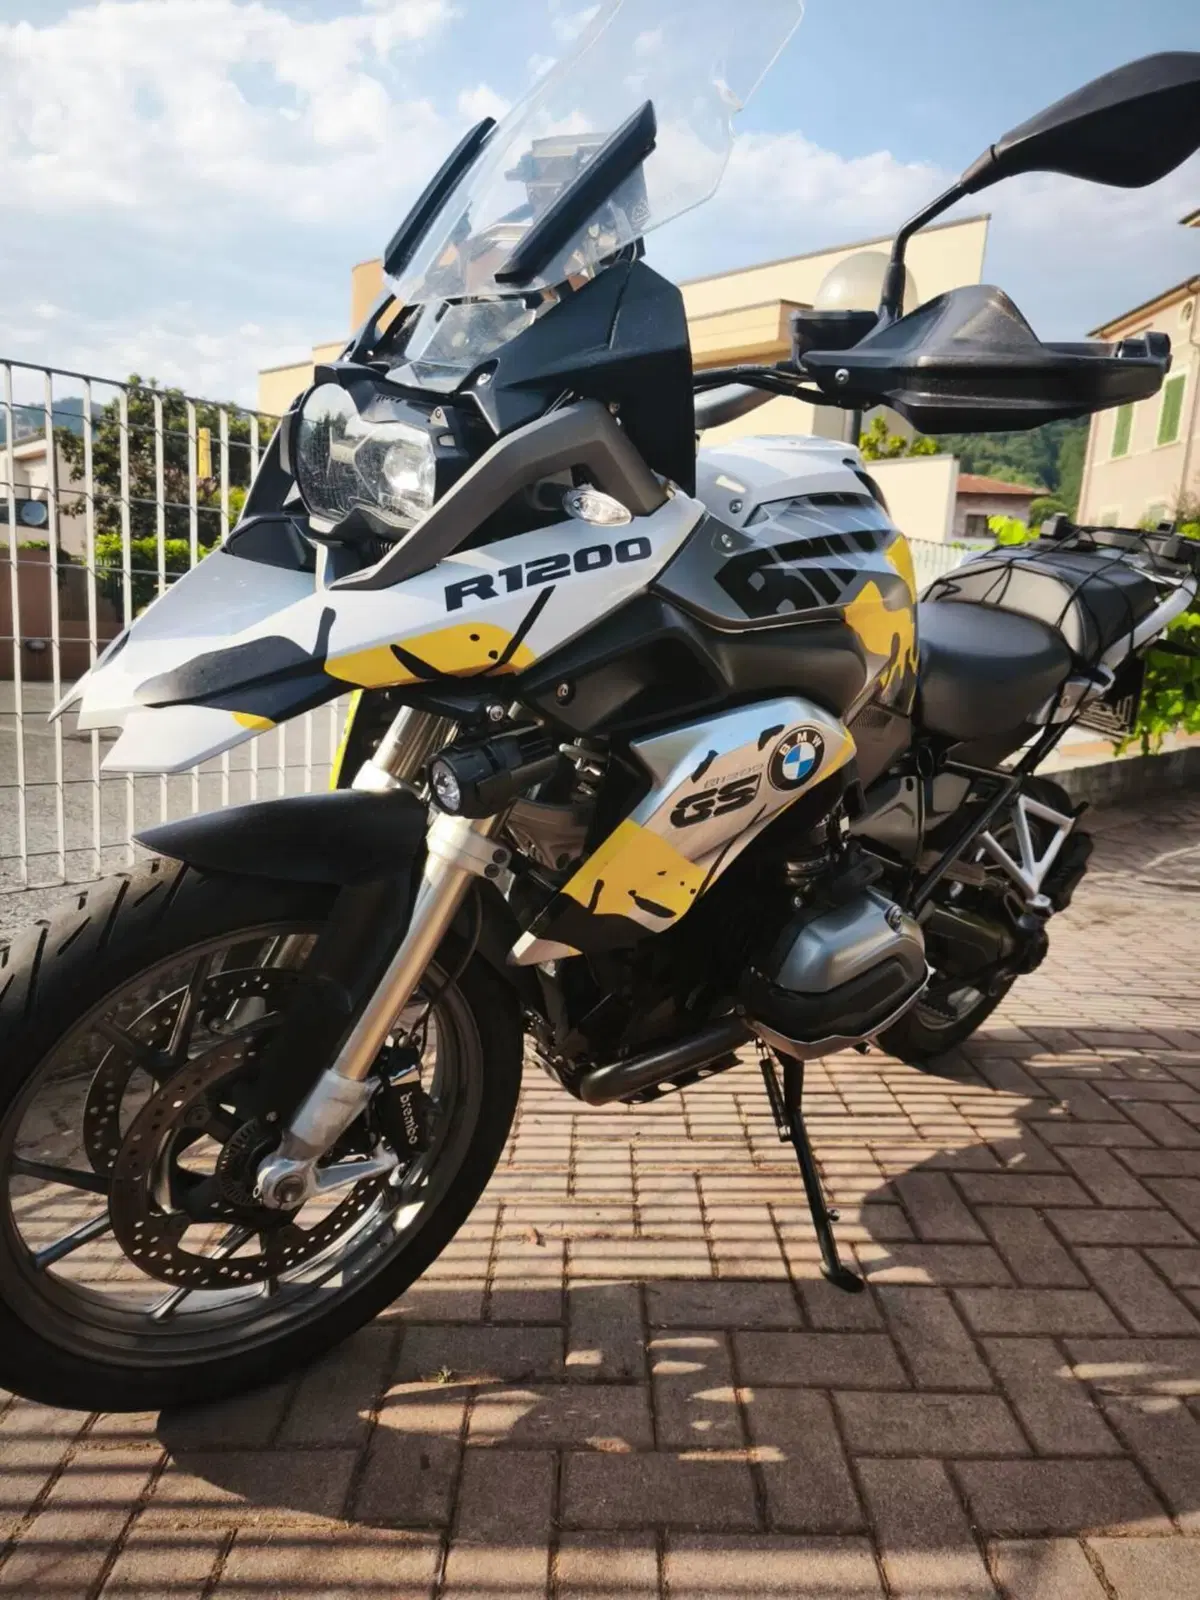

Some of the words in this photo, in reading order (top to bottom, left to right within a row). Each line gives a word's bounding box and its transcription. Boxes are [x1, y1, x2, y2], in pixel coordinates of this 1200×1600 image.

[444, 536, 653, 612] R1200
[779, 732, 823, 757] BMW
[669, 771, 762, 829] GS
[400, 1091, 419, 1145] brembo
